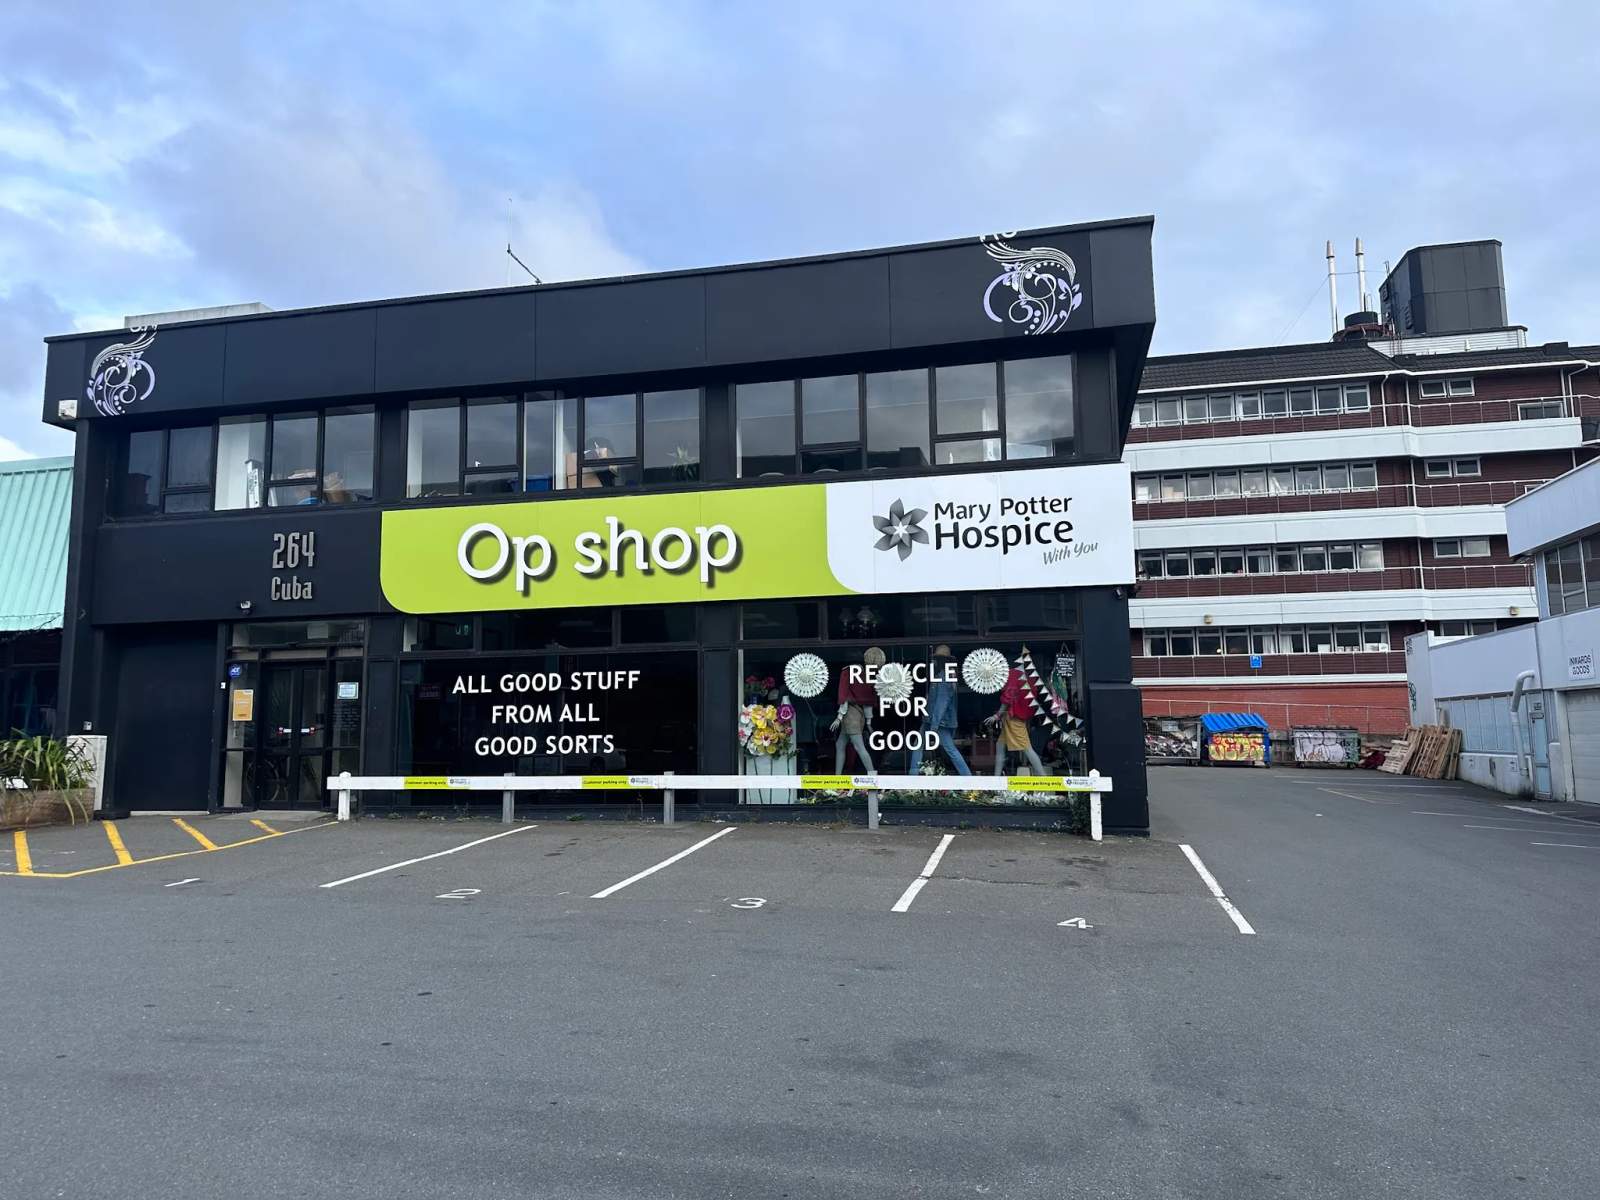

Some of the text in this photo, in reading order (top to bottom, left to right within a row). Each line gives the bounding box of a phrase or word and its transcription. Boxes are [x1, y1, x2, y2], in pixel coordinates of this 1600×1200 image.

[934, 496, 1073, 523] Mary Potter
[935, 516, 1074, 555] Hospice
[272, 531, 315, 569] 264
[457, 516, 738, 592] Op shop
[1043, 542, 1099, 565] With You
[271, 576, 313, 601] Cuba
[452, 674, 492, 694] ALL
[499, 673, 562, 693] GOOD
[570, 670, 641, 691] STUFF
[849, 662, 958, 684] RECYCLE
[491, 703, 600, 724] FROM ALL
[879, 697, 930, 717] FOR
[475, 735, 615, 756] GOOD SORTS
[869, 730, 940, 751] GOOD
[435, 888, 482, 899] 2
[730, 897, 768, 909] 3
[1056, 917, 1094, 929] 4
